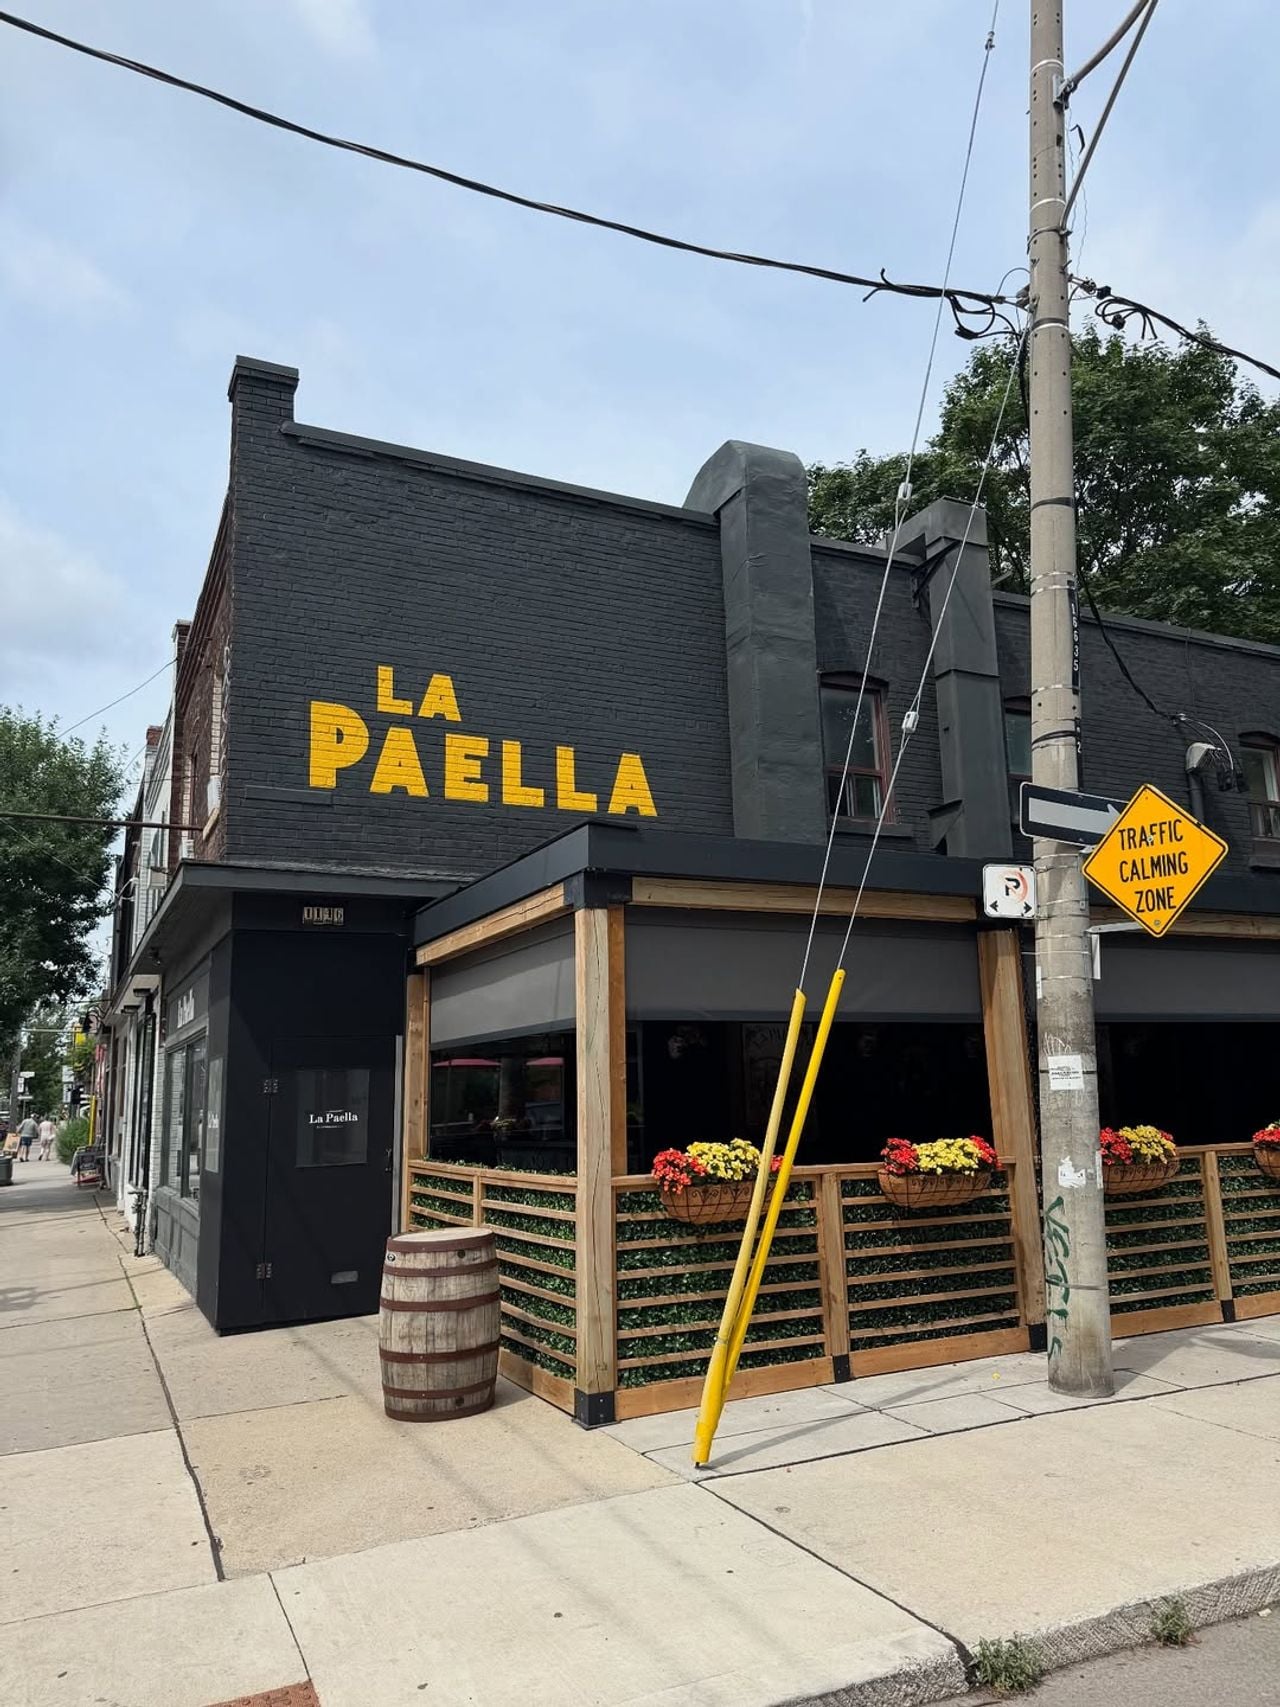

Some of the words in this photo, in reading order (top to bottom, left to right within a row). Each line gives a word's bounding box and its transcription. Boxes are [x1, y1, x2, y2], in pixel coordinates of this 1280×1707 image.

[1071, 603, 1080, 672] 16635
[377, 665, 462, 722] LA
[309, 701, 658, 817] PAELLA
[1118, 819, 1184, 851] TRAFFIC
[1119, 851, 1189, 883] CALMING
[1135, 886, 1176, 913] ZONE
[309, 1114, 323, 1124] La
[325, 1112, 358, 1123] Paella
